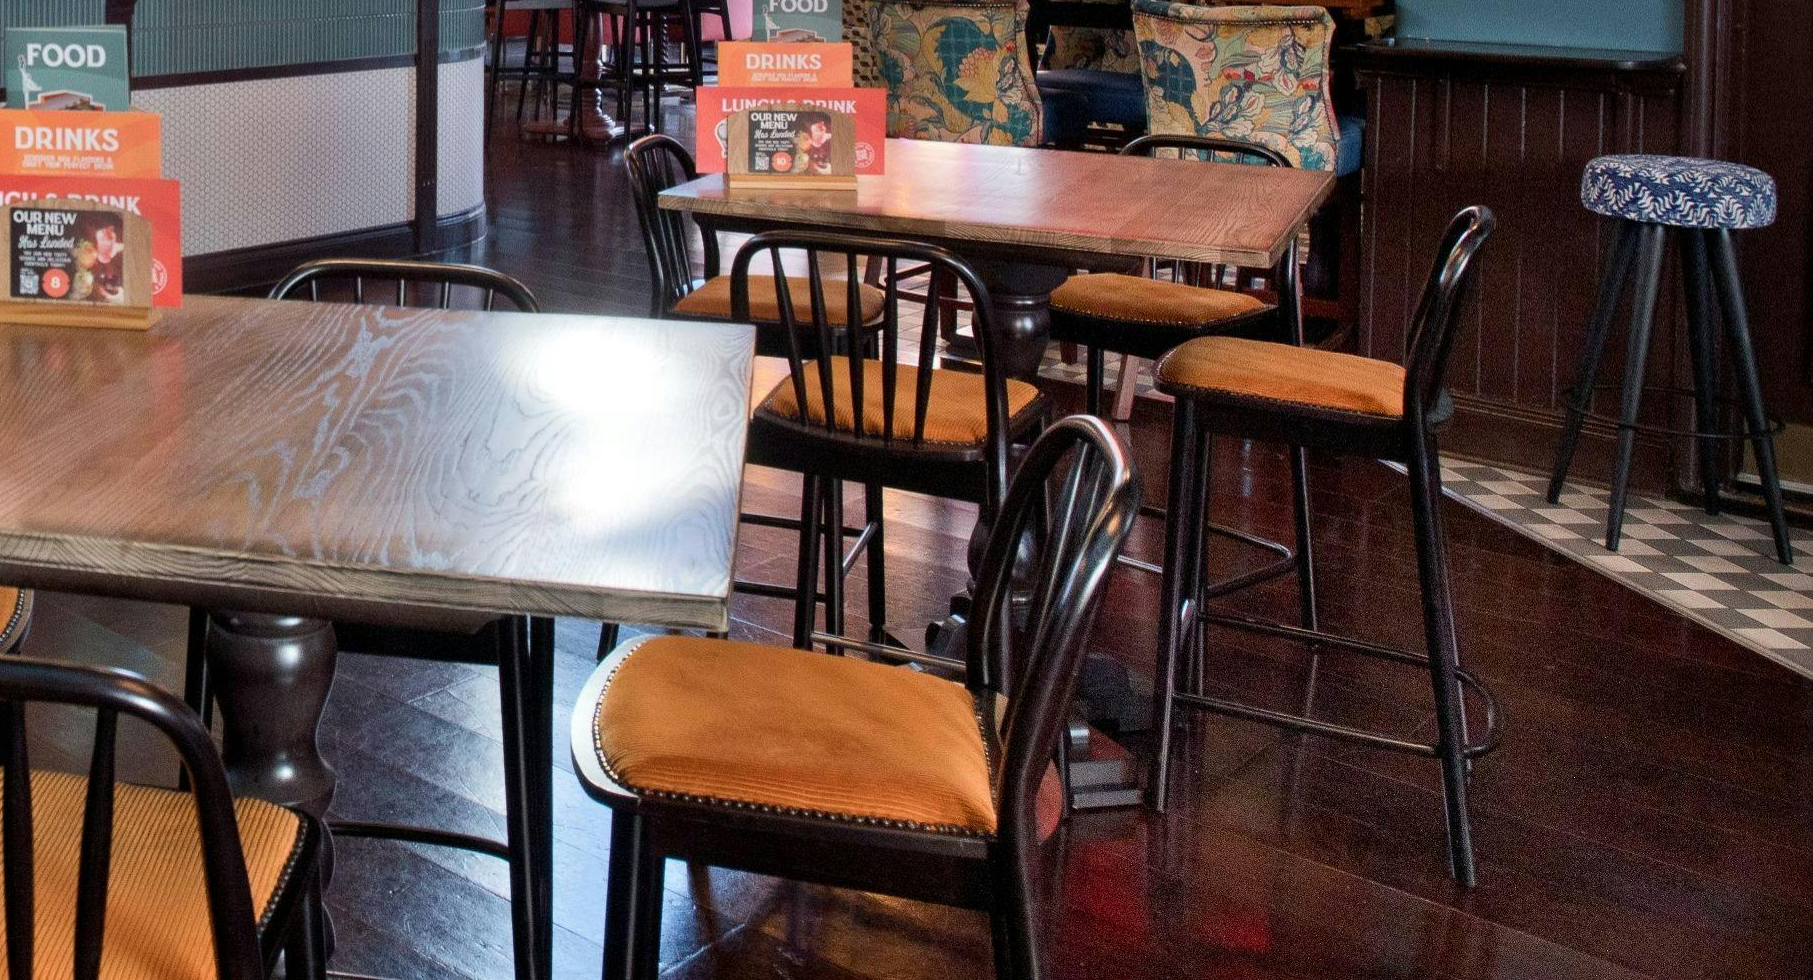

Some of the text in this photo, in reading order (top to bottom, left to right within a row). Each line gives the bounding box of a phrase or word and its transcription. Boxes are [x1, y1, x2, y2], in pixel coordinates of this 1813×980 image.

[26, 42, 107, 68] FOOD
[746, 53, 822, 70] DRINKS
[750, 112, 798, 122] OUR NEW
[760, 121, 788, 129] MENU
[15, 126, 119, 151] DRINKS
[754, 129, 796, 139] Has Landed
[13, 210, 77, 225] OUR NEW
[27, 223, 64, 236] MENU
[18, 234, 75, 249] Has Landed
[50, 276, 61, 289] 8
